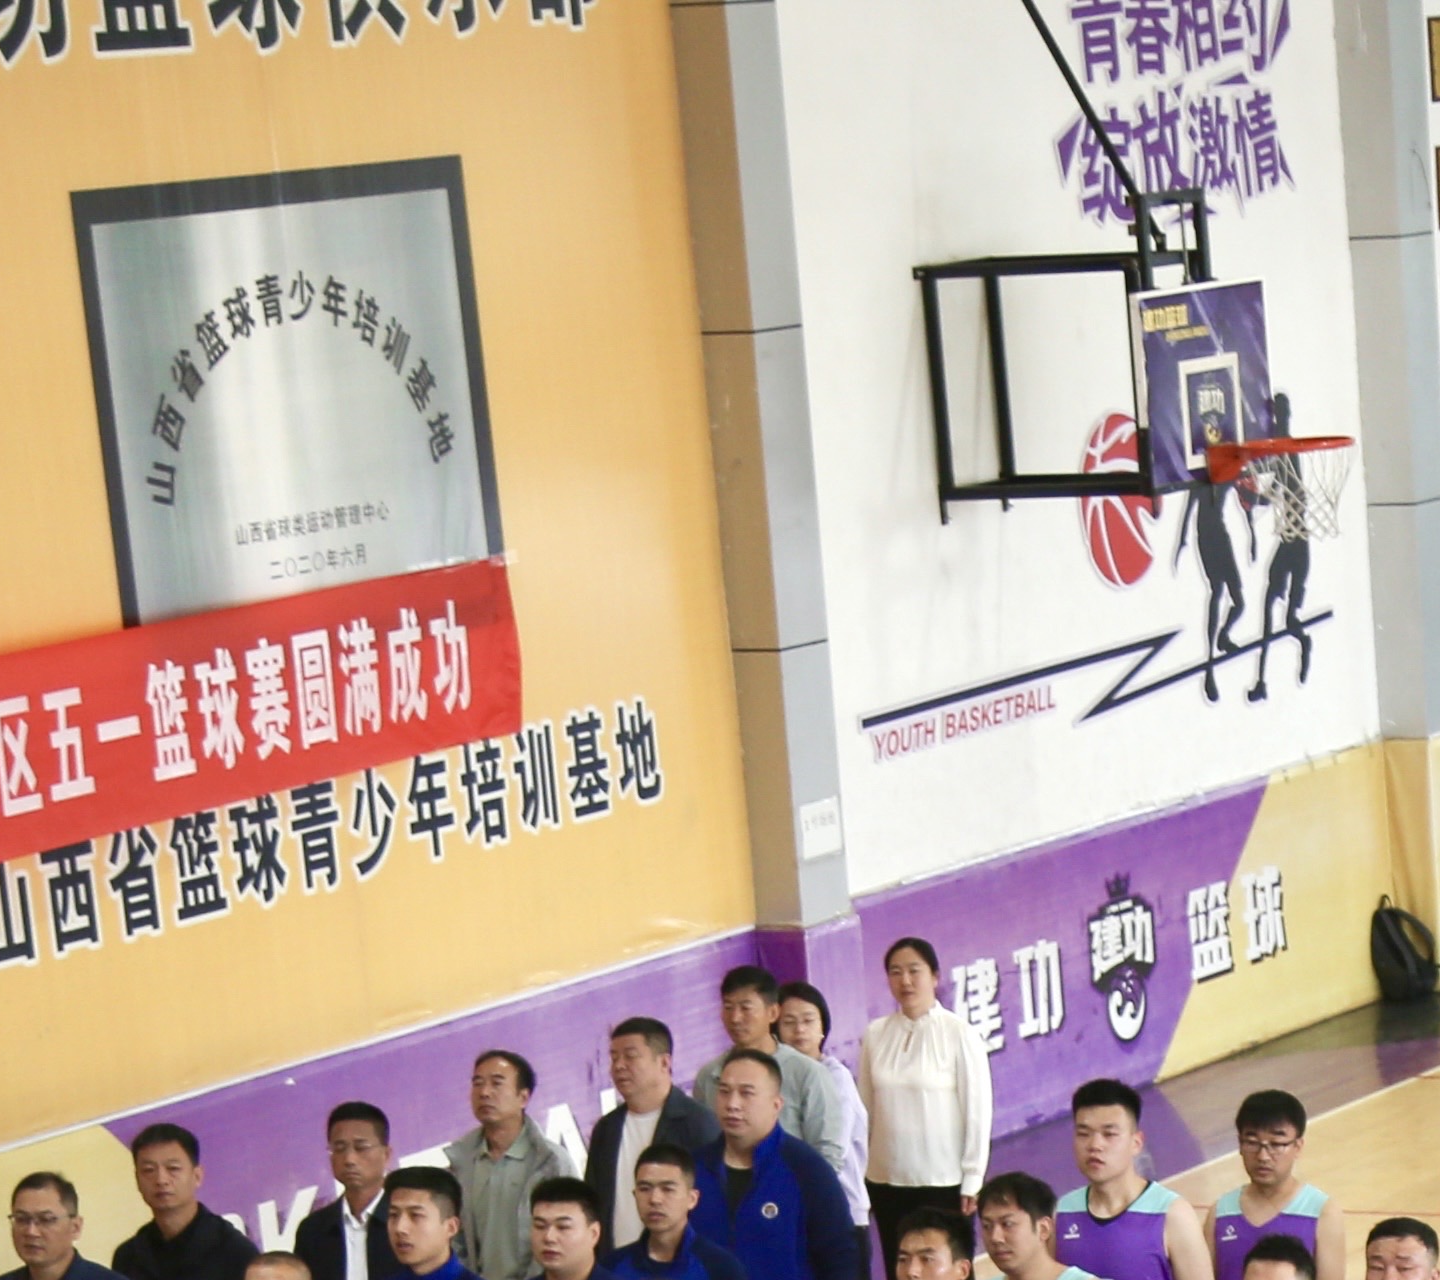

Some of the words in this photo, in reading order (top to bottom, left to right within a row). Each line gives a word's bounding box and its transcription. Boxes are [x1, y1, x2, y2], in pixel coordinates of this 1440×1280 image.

[145, 270, 455, 507] 山西省篮球青少年培训基地
[875, 718, 937, 759] YOUTH
[944, 685, 1057, 739] BASKETBALL
[951, 939, 1066, 1054] 建功
[1089, 903, 1156, 984] 建功
[1187, 865, 1289, 985] 篮球
